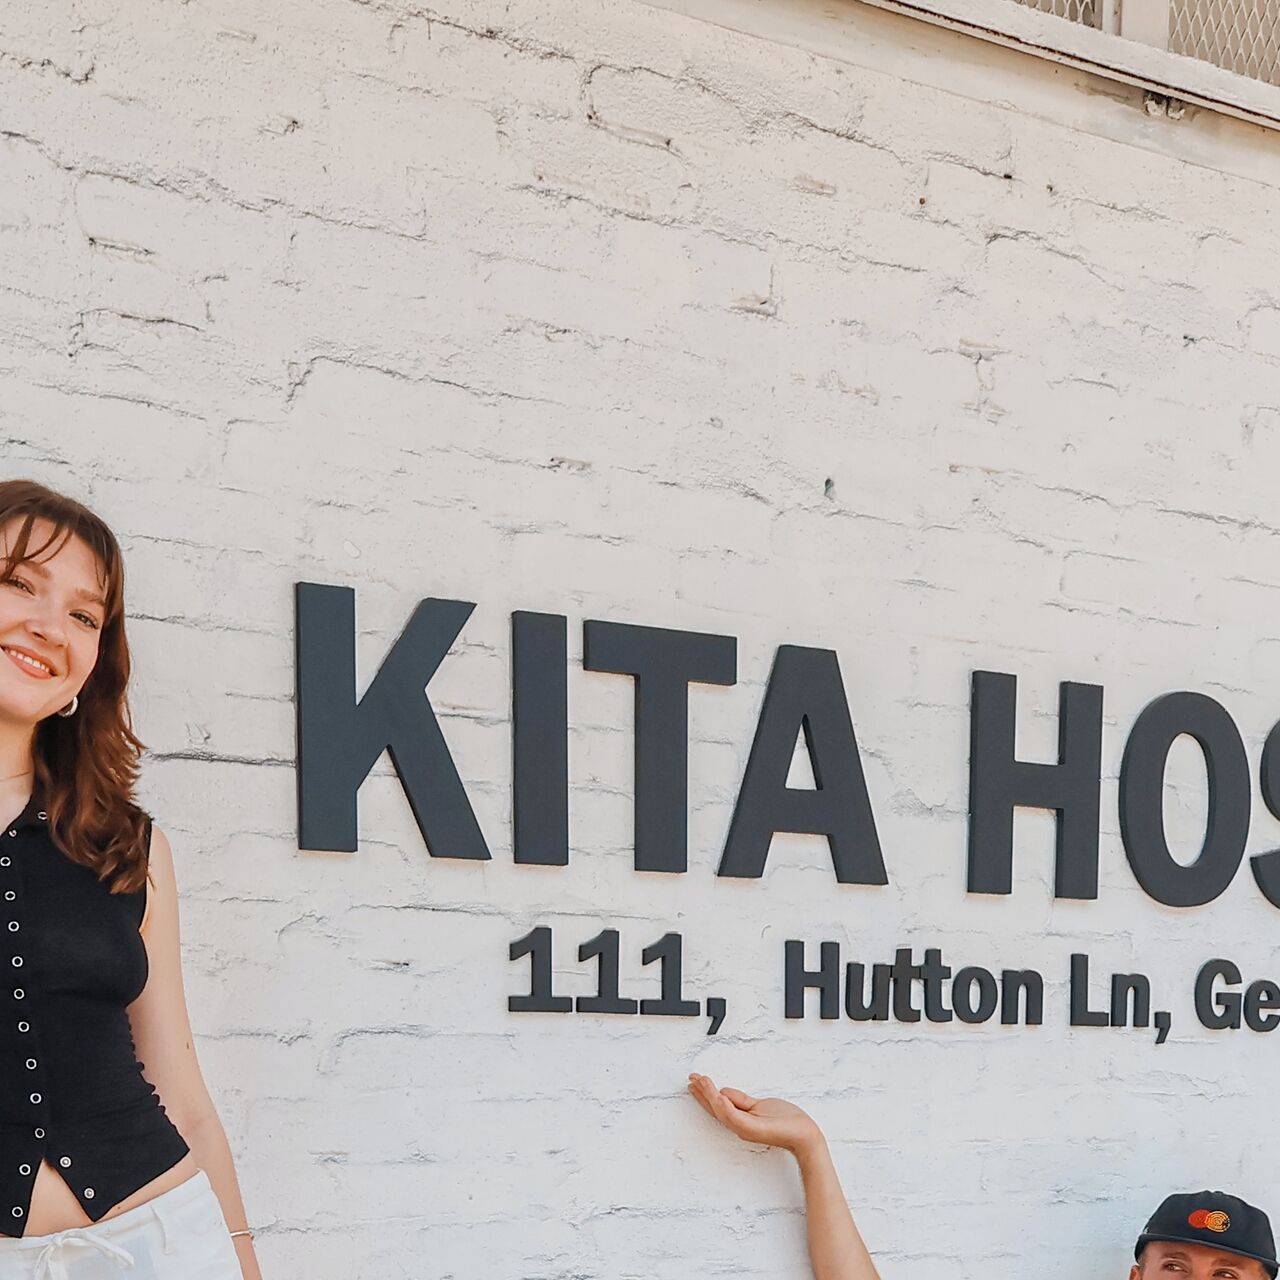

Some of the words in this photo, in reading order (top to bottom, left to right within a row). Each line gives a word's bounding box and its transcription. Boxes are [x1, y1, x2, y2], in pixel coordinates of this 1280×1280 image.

[291, 582, 888, 886] KITA
[507, 926, 727, 1036] 111,
[783, 939, 1044, 1026] Hutton
[1069, 953, 1172, 1045] Ln,
